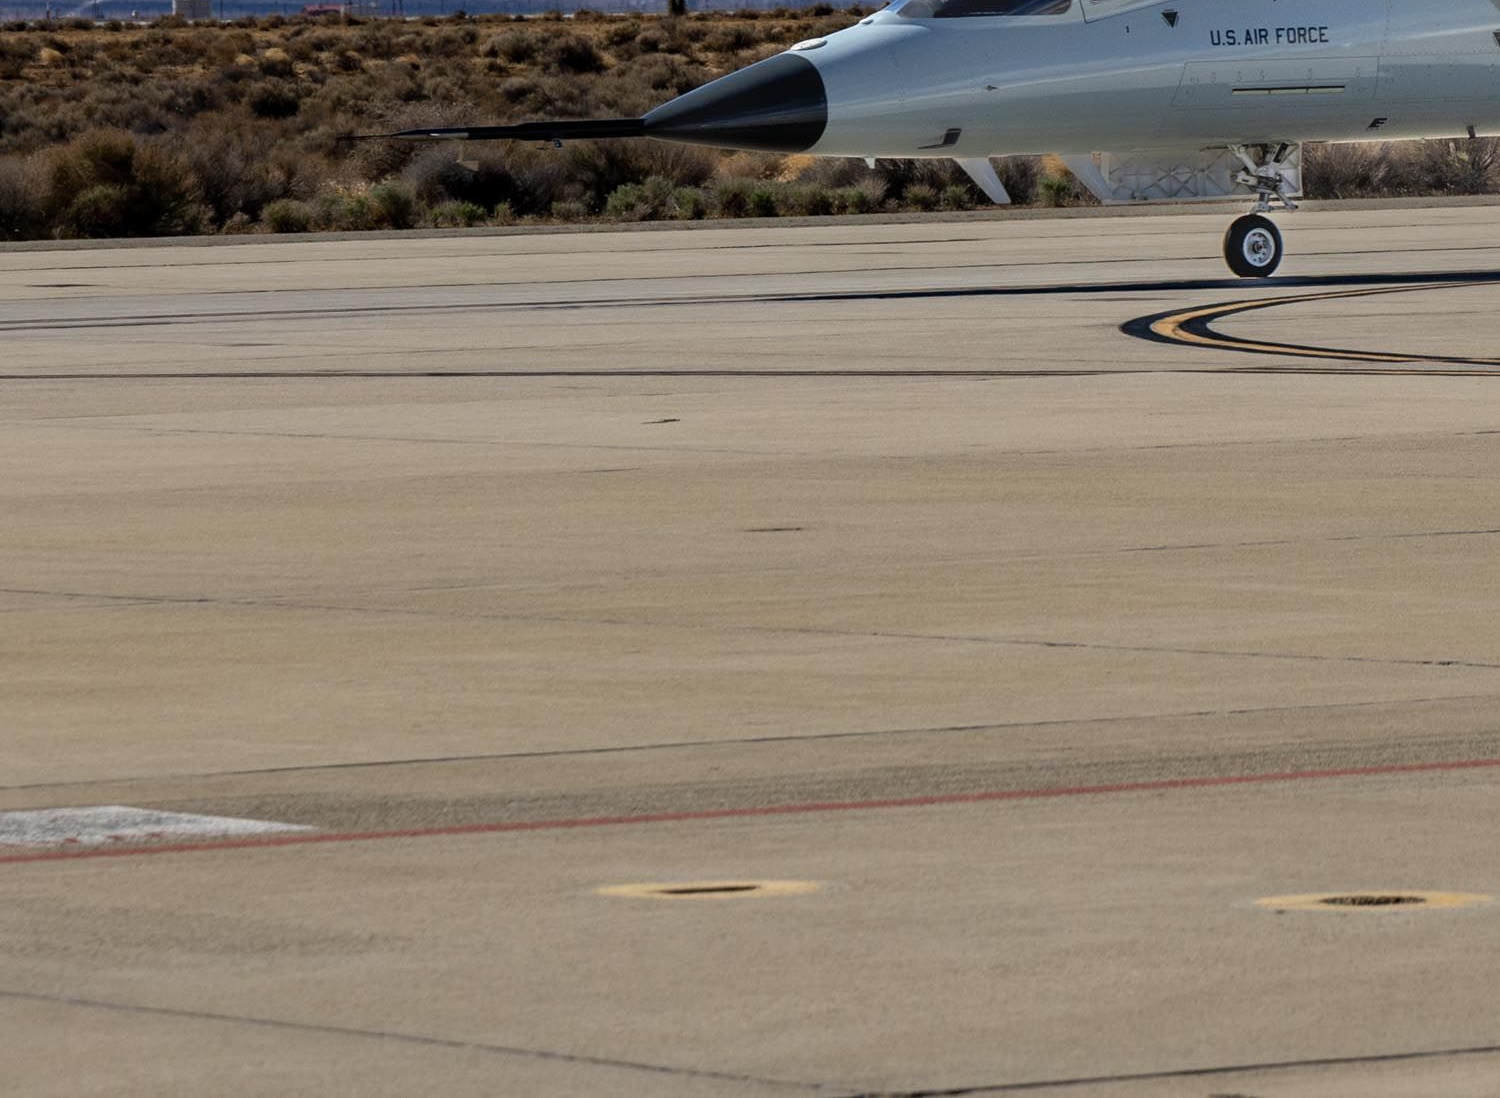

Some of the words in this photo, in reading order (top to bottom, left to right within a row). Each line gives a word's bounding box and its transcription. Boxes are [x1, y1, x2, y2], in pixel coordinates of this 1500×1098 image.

[1210, 29, 1241, 46] U.S.
[1244, 28, 1269, 45] AIR
[1275, 26, 1329, 44] FORCE
